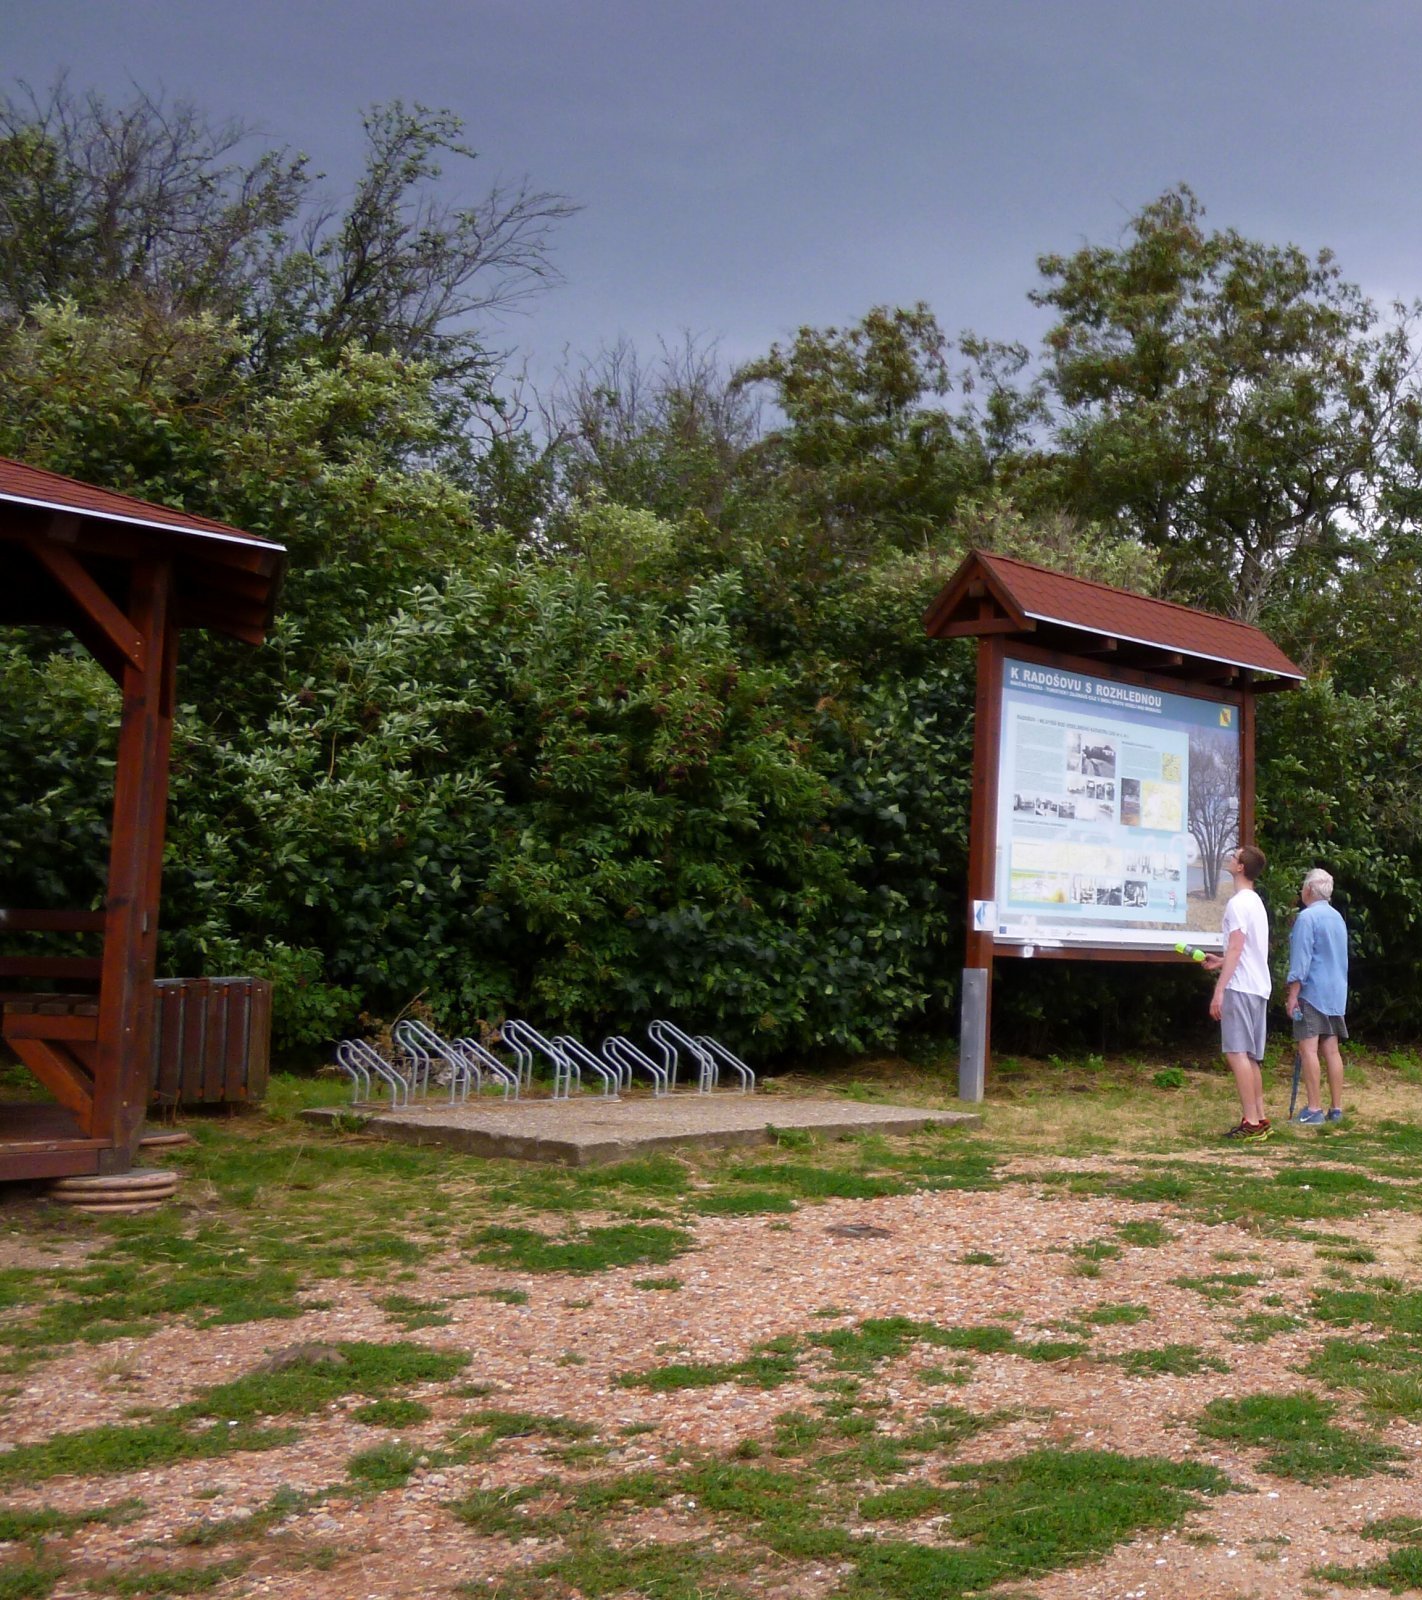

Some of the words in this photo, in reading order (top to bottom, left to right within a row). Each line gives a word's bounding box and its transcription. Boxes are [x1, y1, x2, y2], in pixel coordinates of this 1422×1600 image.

[1011, 667, 1019, 680] K
[1023, 669, 1081, 691] RADOŠOVU
[1085, 682, 1092, 694] S
[1096, 684, 1162, 707] ROZHLEDNOU
